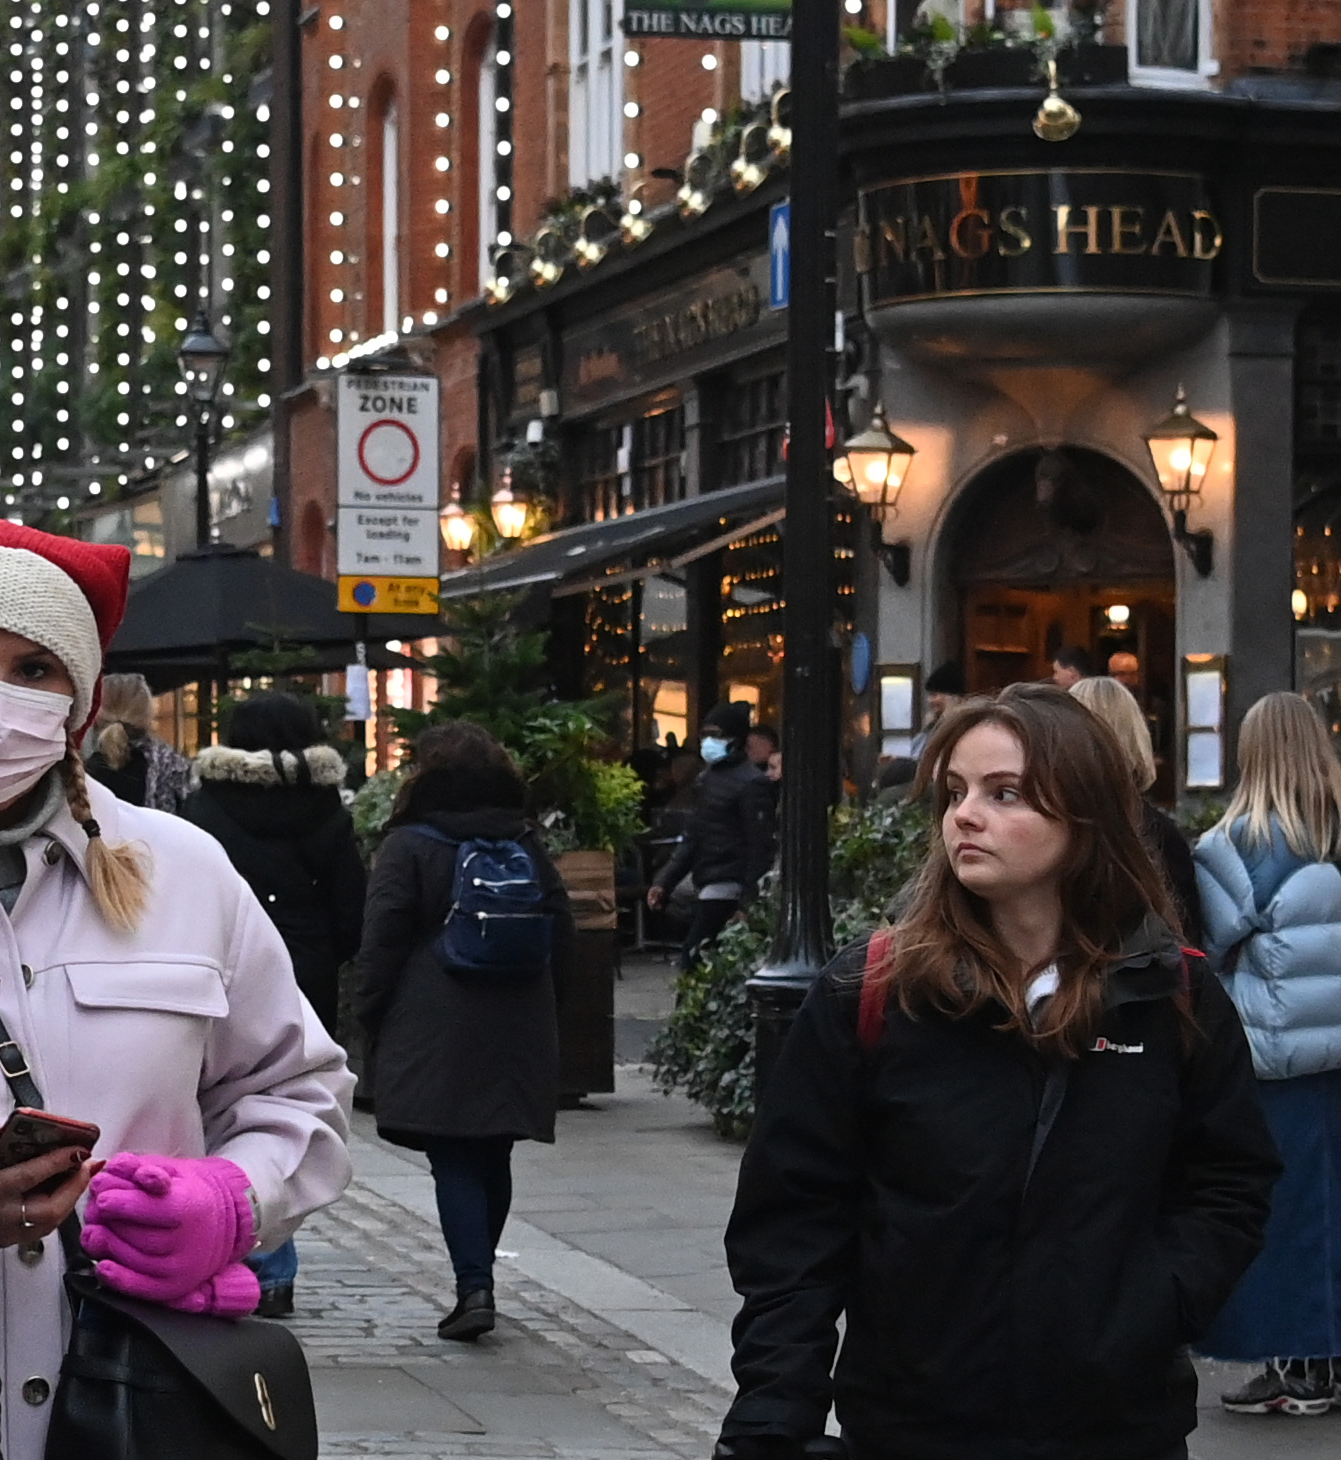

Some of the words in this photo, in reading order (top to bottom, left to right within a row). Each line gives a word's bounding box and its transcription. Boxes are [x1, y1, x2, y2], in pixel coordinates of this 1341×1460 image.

[628, 10, 674, 33] THE
[679, 12, 746, 35] NAGS
[750, 14, 793, 36] HEA
[874, 204, 1032, 268] NAGS
[1049, 204, 1223, 260] HEAD
[346, 376, 430, 393] PEDESTRIAN
[359, 396, 419, 414] ZONE
[353, 491, 371, 502] No
[357, 515, 398, 529] Except
[402, 515, 420, 527] for
[366, 529, 410, 543] loading
[356, 553, 381, 565] 7am
